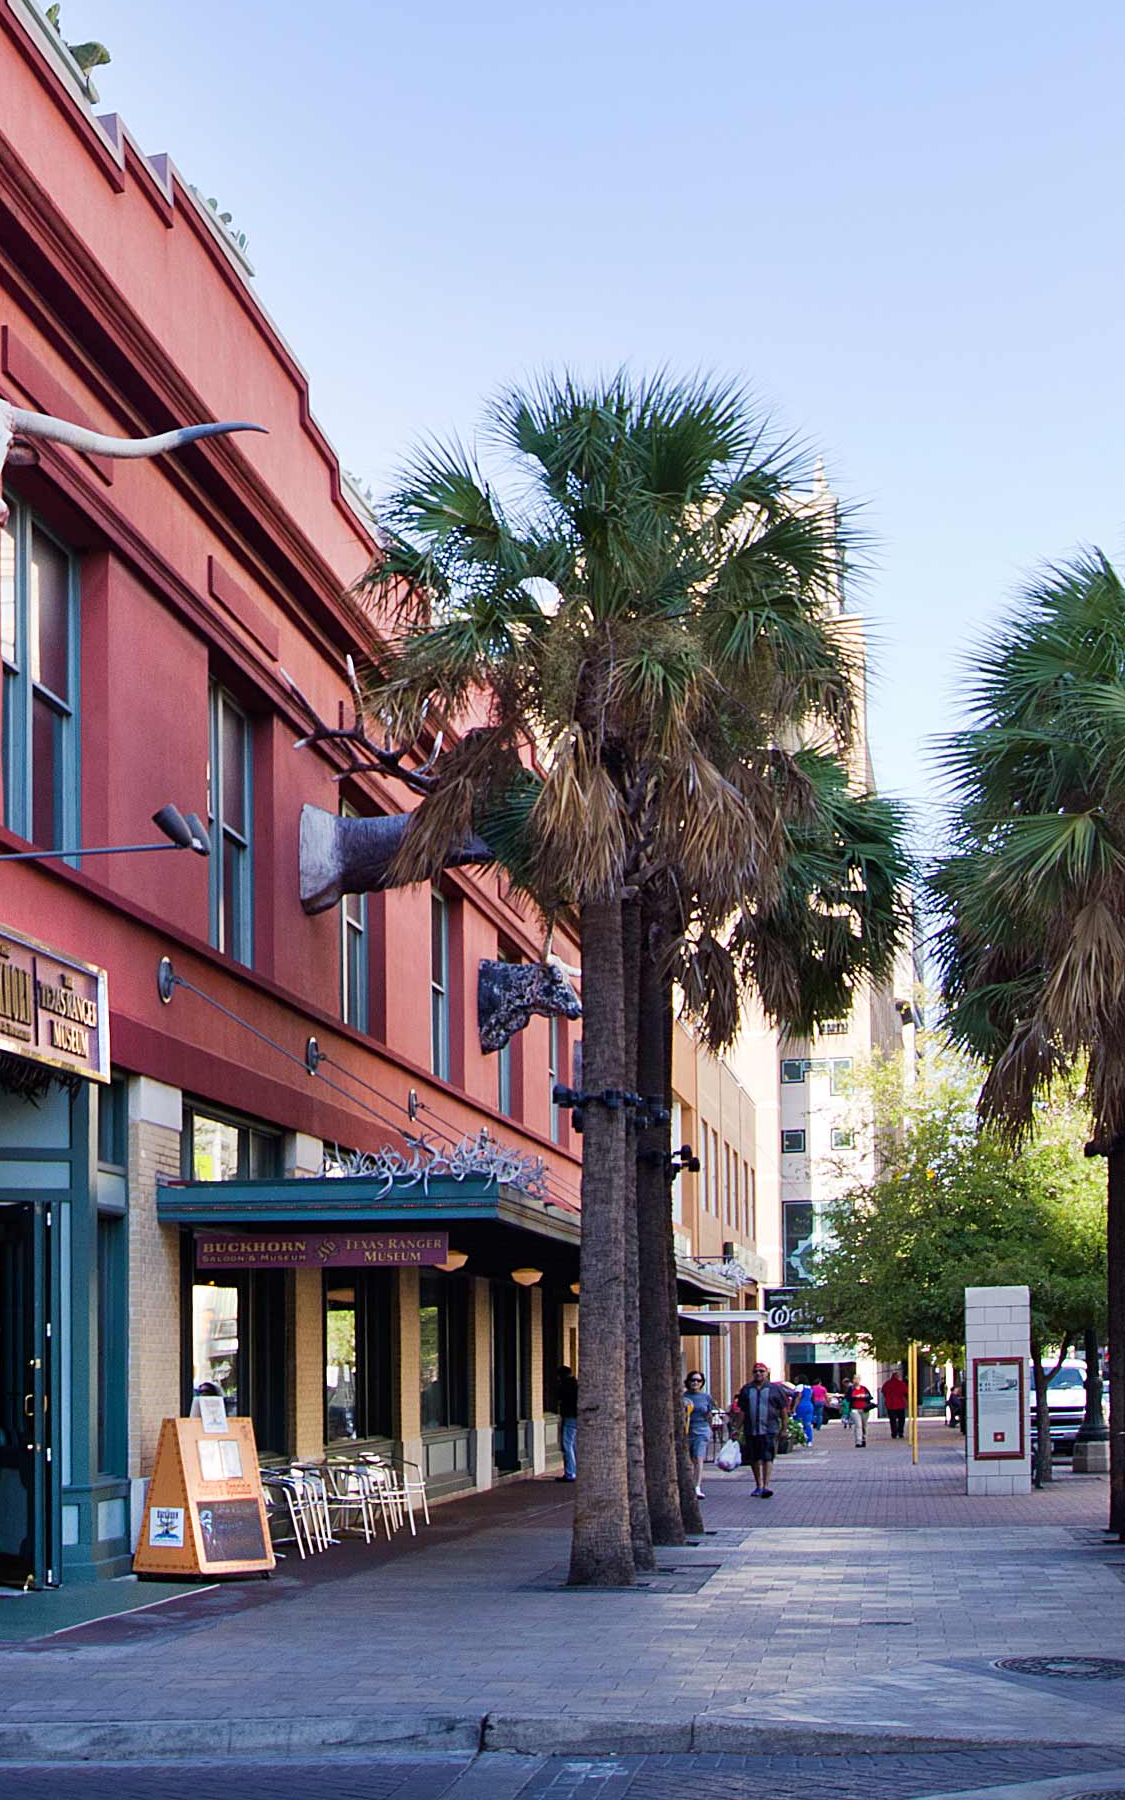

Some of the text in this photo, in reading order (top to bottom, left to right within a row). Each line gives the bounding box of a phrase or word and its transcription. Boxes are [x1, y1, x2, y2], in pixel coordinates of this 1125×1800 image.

[53, 1020, 89, 1058] MUSEUM
[203, 1241, 307, 1253] BUCKHORN
[345, 1238, 443, 1250] TEXAS RANGER
[363, 1251, 421, 1262] MUSEUM
